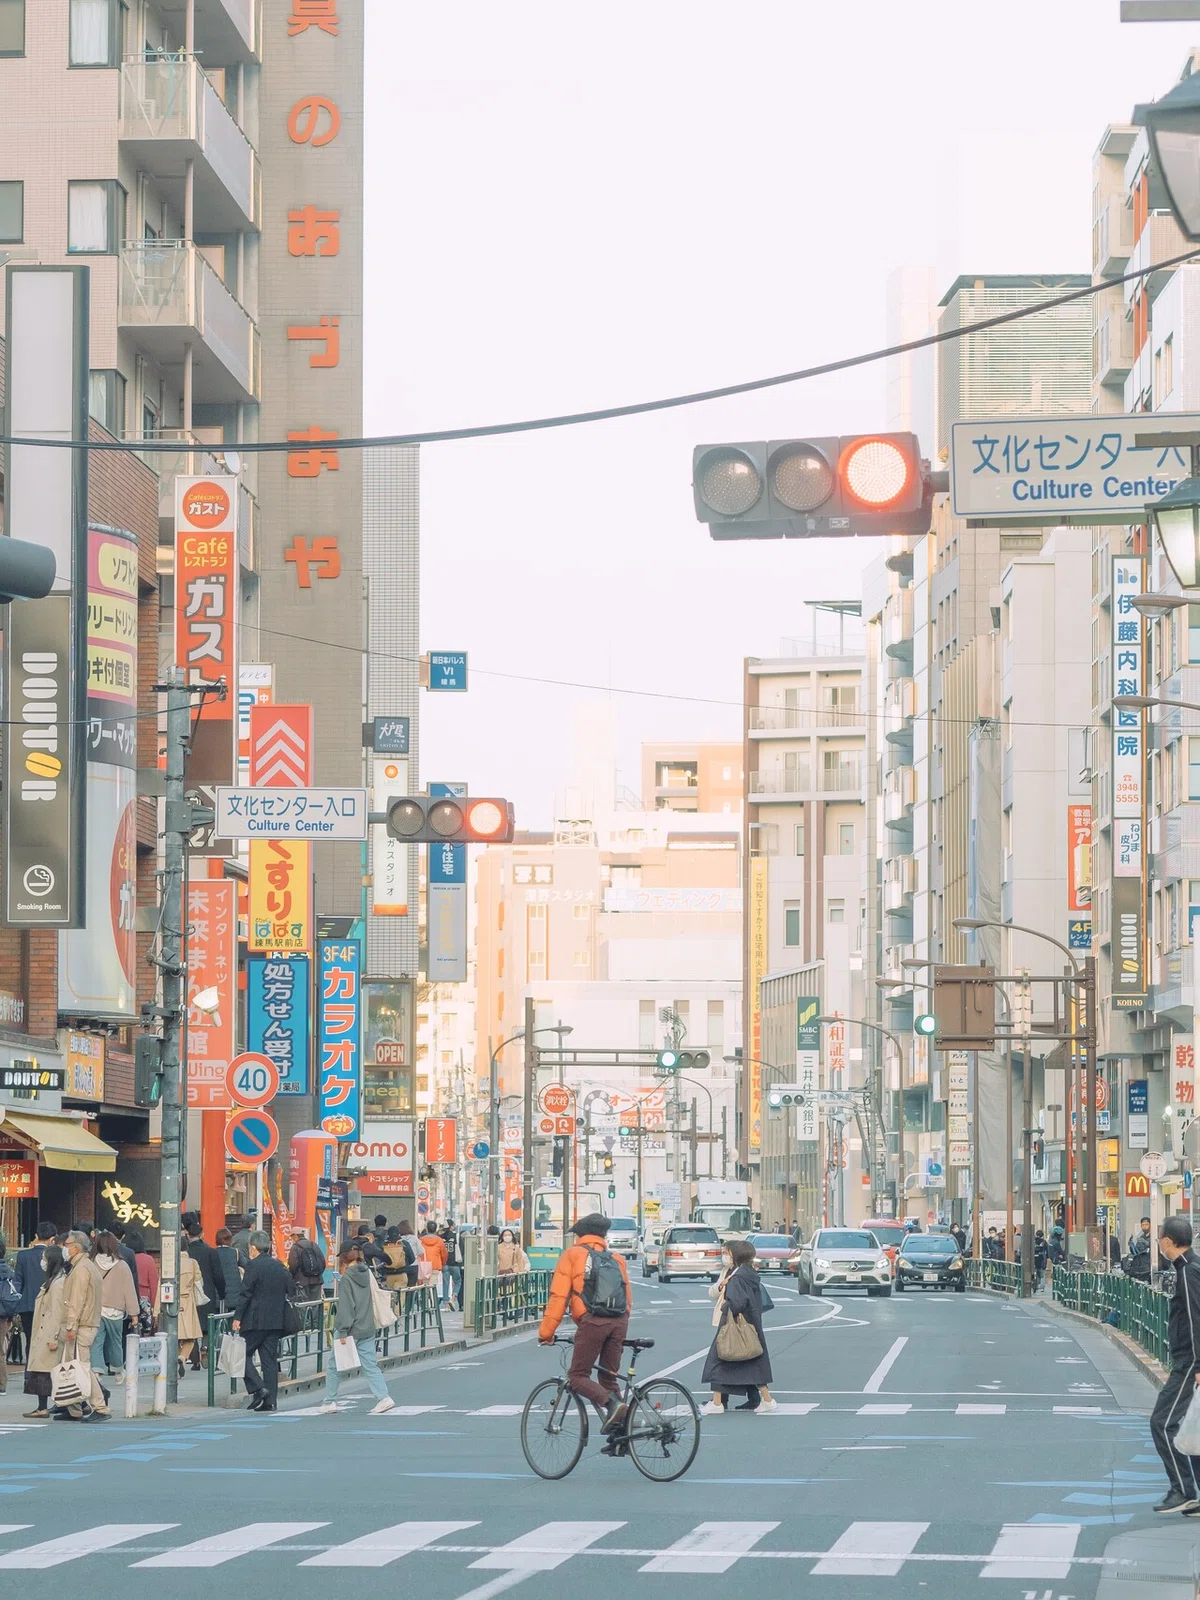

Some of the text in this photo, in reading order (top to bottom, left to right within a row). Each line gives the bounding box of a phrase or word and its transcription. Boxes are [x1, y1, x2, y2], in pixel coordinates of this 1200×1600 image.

[1012, 476, 1177, 501] Culture Center
[189, 502, 225, 515] ガスト
[183, 538, 228, 555] Café
[184, 557, 227, 567] レストラン
[1117, 594, 1139, 757] 伊藤内科医院
[22, 652, 62, 801] DOUTOR
[1116, 783, 1139, 792] 3948
[227, 794, 356, 818] 文化センター入口
[1116, 794, 1139, 803] 5555
[247, 819, 335, 833] Culture Center
[1120, 835, 1131, 864] 皮フ科
[17, 903, 42, 912] Smoking
[254, 939, 303, 948] 練馬駅前店
[1120, 913, 1140, 984] DOUTOR
[323, 945, 356, 962] 3F4F
[1117, 999, 1143, 1007] KOHNO
[263, 963, 293, 1078] 処方せん受付
[323, 966, 356, 1108] カラオケ
[798, 1026, 818, 1034] SMBC
[376, 1045, 404, 1063] OPEN
[4, 1071, 59, 1087] DOUTOR
[238, 1068, 268, 1092] 40
[802, 1055, 814, 1136] 三井住友銀行
[330, 1123, 353, 1134] トマト
[349, 1141, 408, 1158] omo
[435, 1120, 446, 1162] ラーメン
[369, 1175, 410, 1183] ドコモショップ
[101, 1180, 160, 1229] やすべえ
